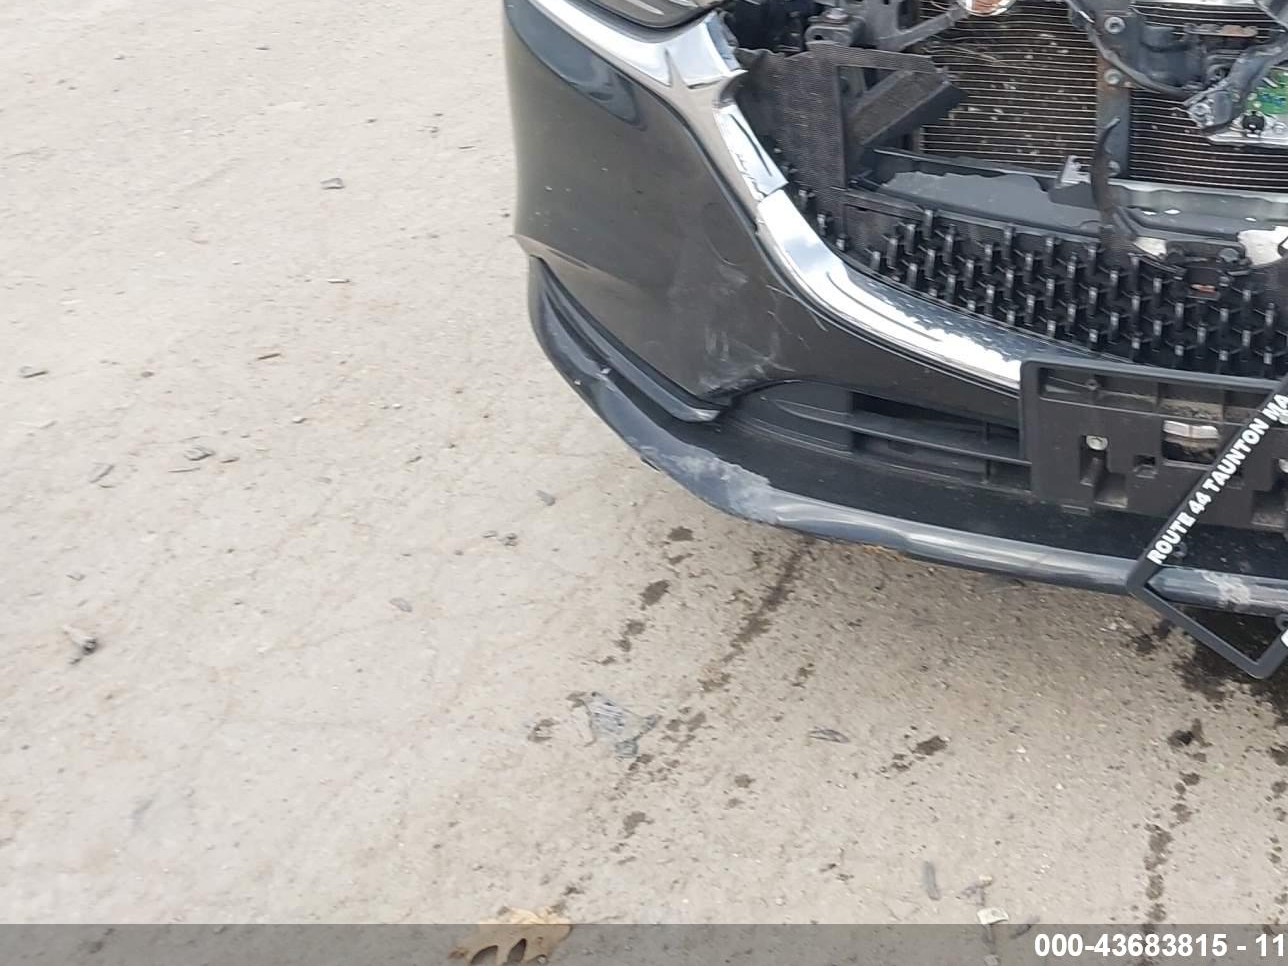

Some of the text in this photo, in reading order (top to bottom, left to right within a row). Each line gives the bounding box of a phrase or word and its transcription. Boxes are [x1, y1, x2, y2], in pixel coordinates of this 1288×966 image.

[1147, 511, 1196, 565] ROUTE
[1188, 491, 1212, 514] 44
[1202, 417, 1270, 492] TAUNTON
